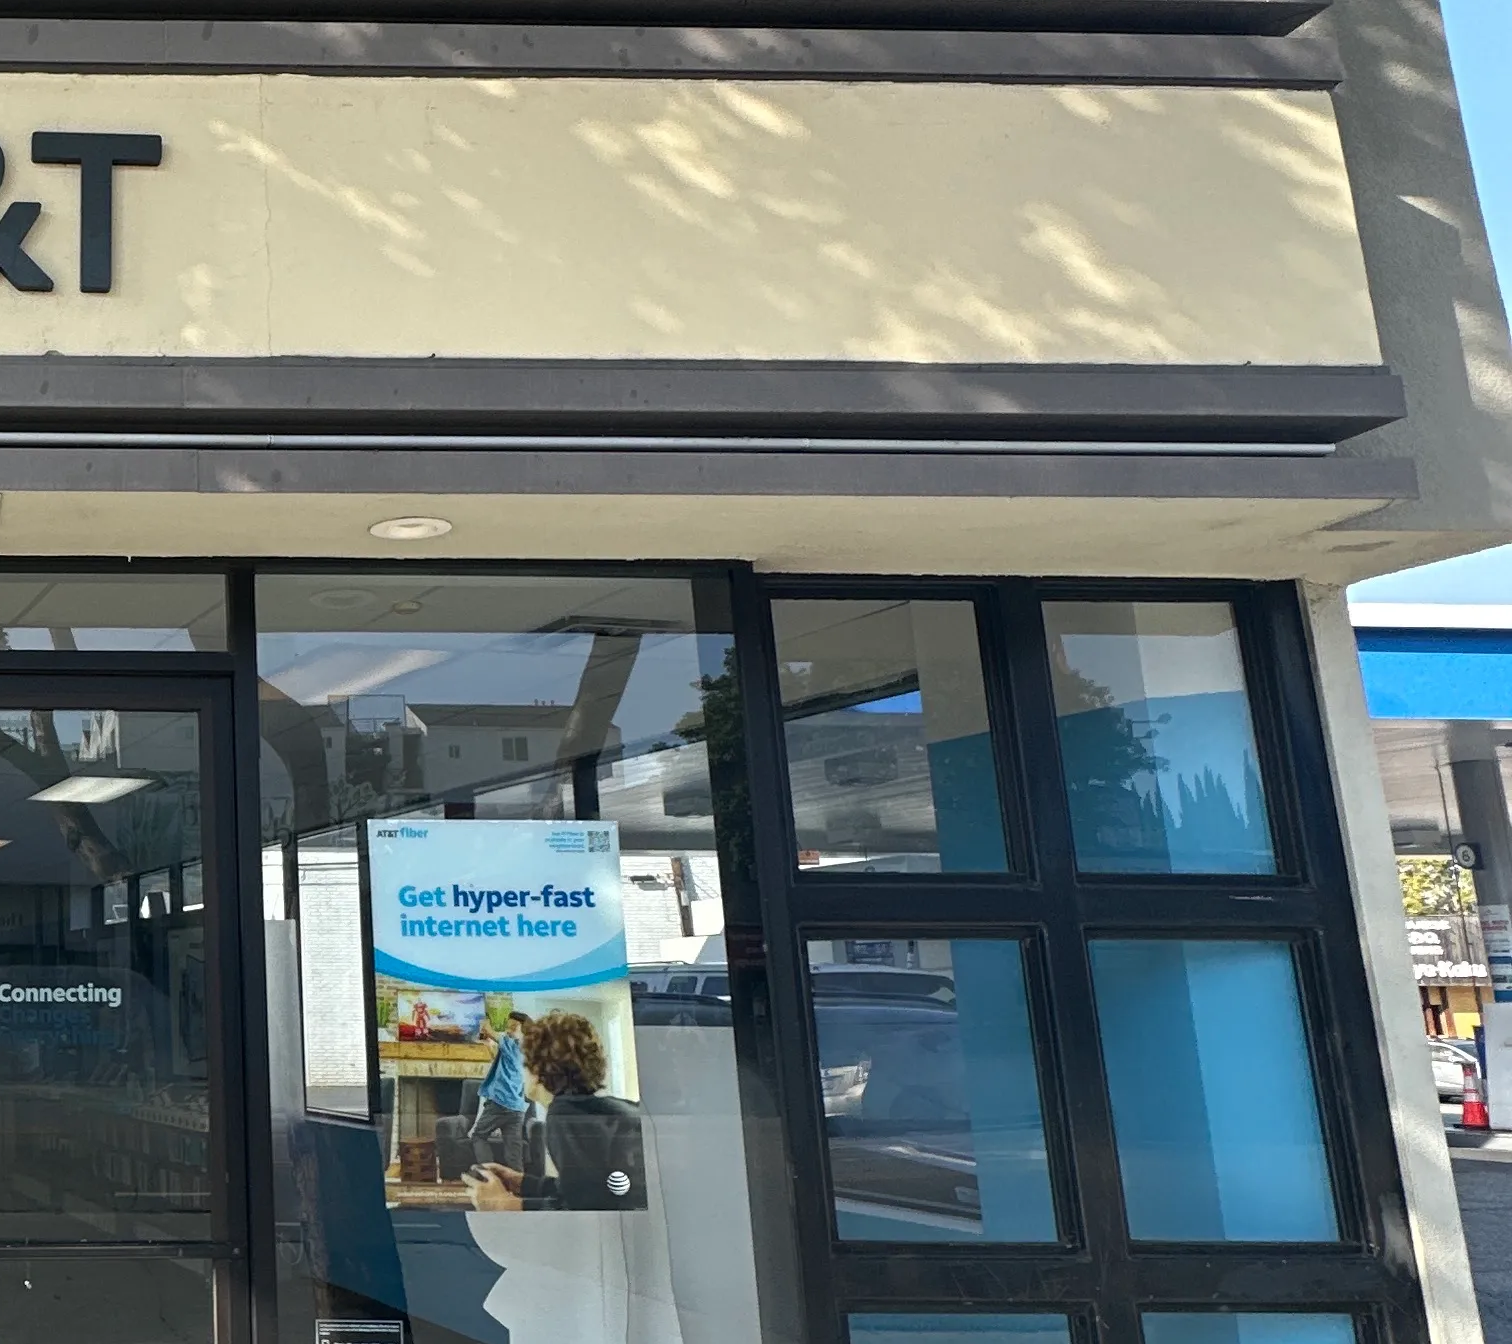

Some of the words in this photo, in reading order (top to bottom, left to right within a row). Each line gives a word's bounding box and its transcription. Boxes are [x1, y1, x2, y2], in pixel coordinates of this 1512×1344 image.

[398, 885, 447, 907] Get
[453, 884, 596, 913] hyper-fast
[400, 913, 512, 937] internet
[517, 913, 577, 937] here
